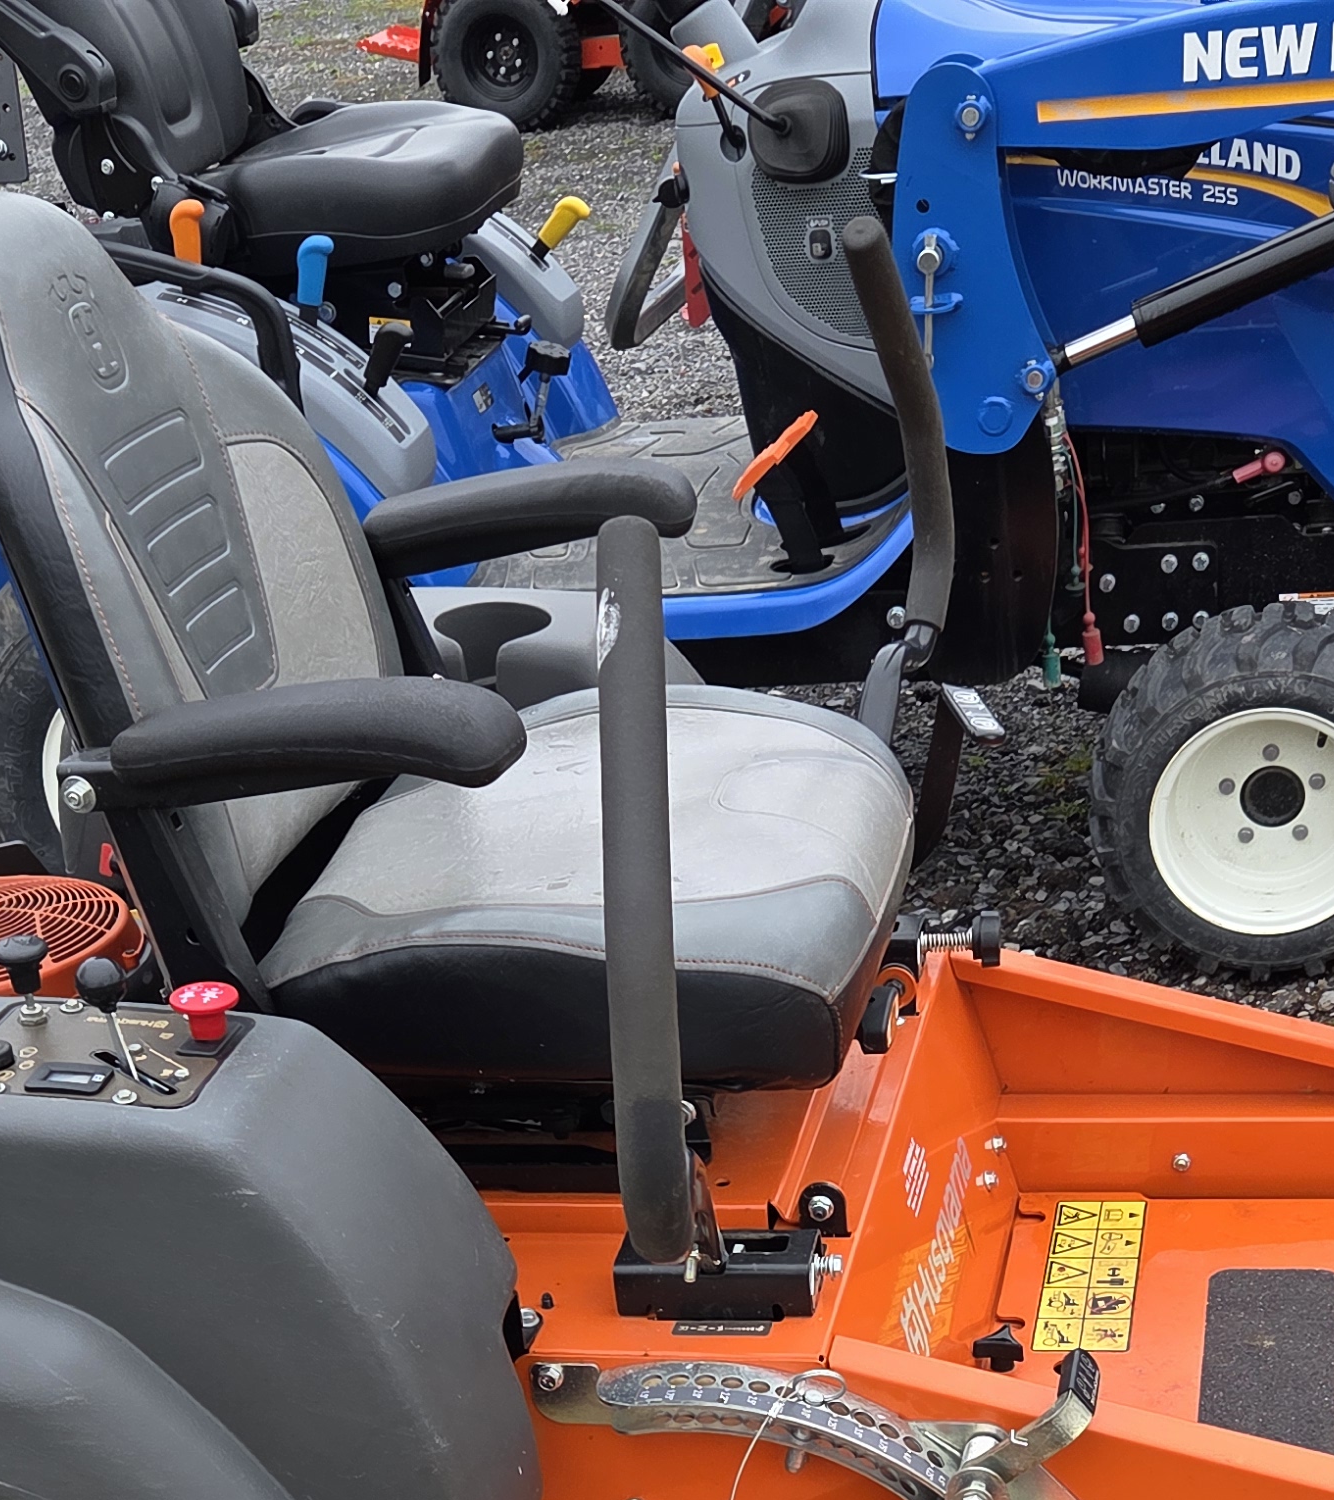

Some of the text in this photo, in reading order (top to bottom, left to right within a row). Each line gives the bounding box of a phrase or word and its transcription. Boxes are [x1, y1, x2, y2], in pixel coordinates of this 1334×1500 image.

[1182, 22, 1318, 83] NEW
[1057, 168, 1239, 206] WORKMASTER 25S
[912, 1136, 972, 1334] Husqvarna
